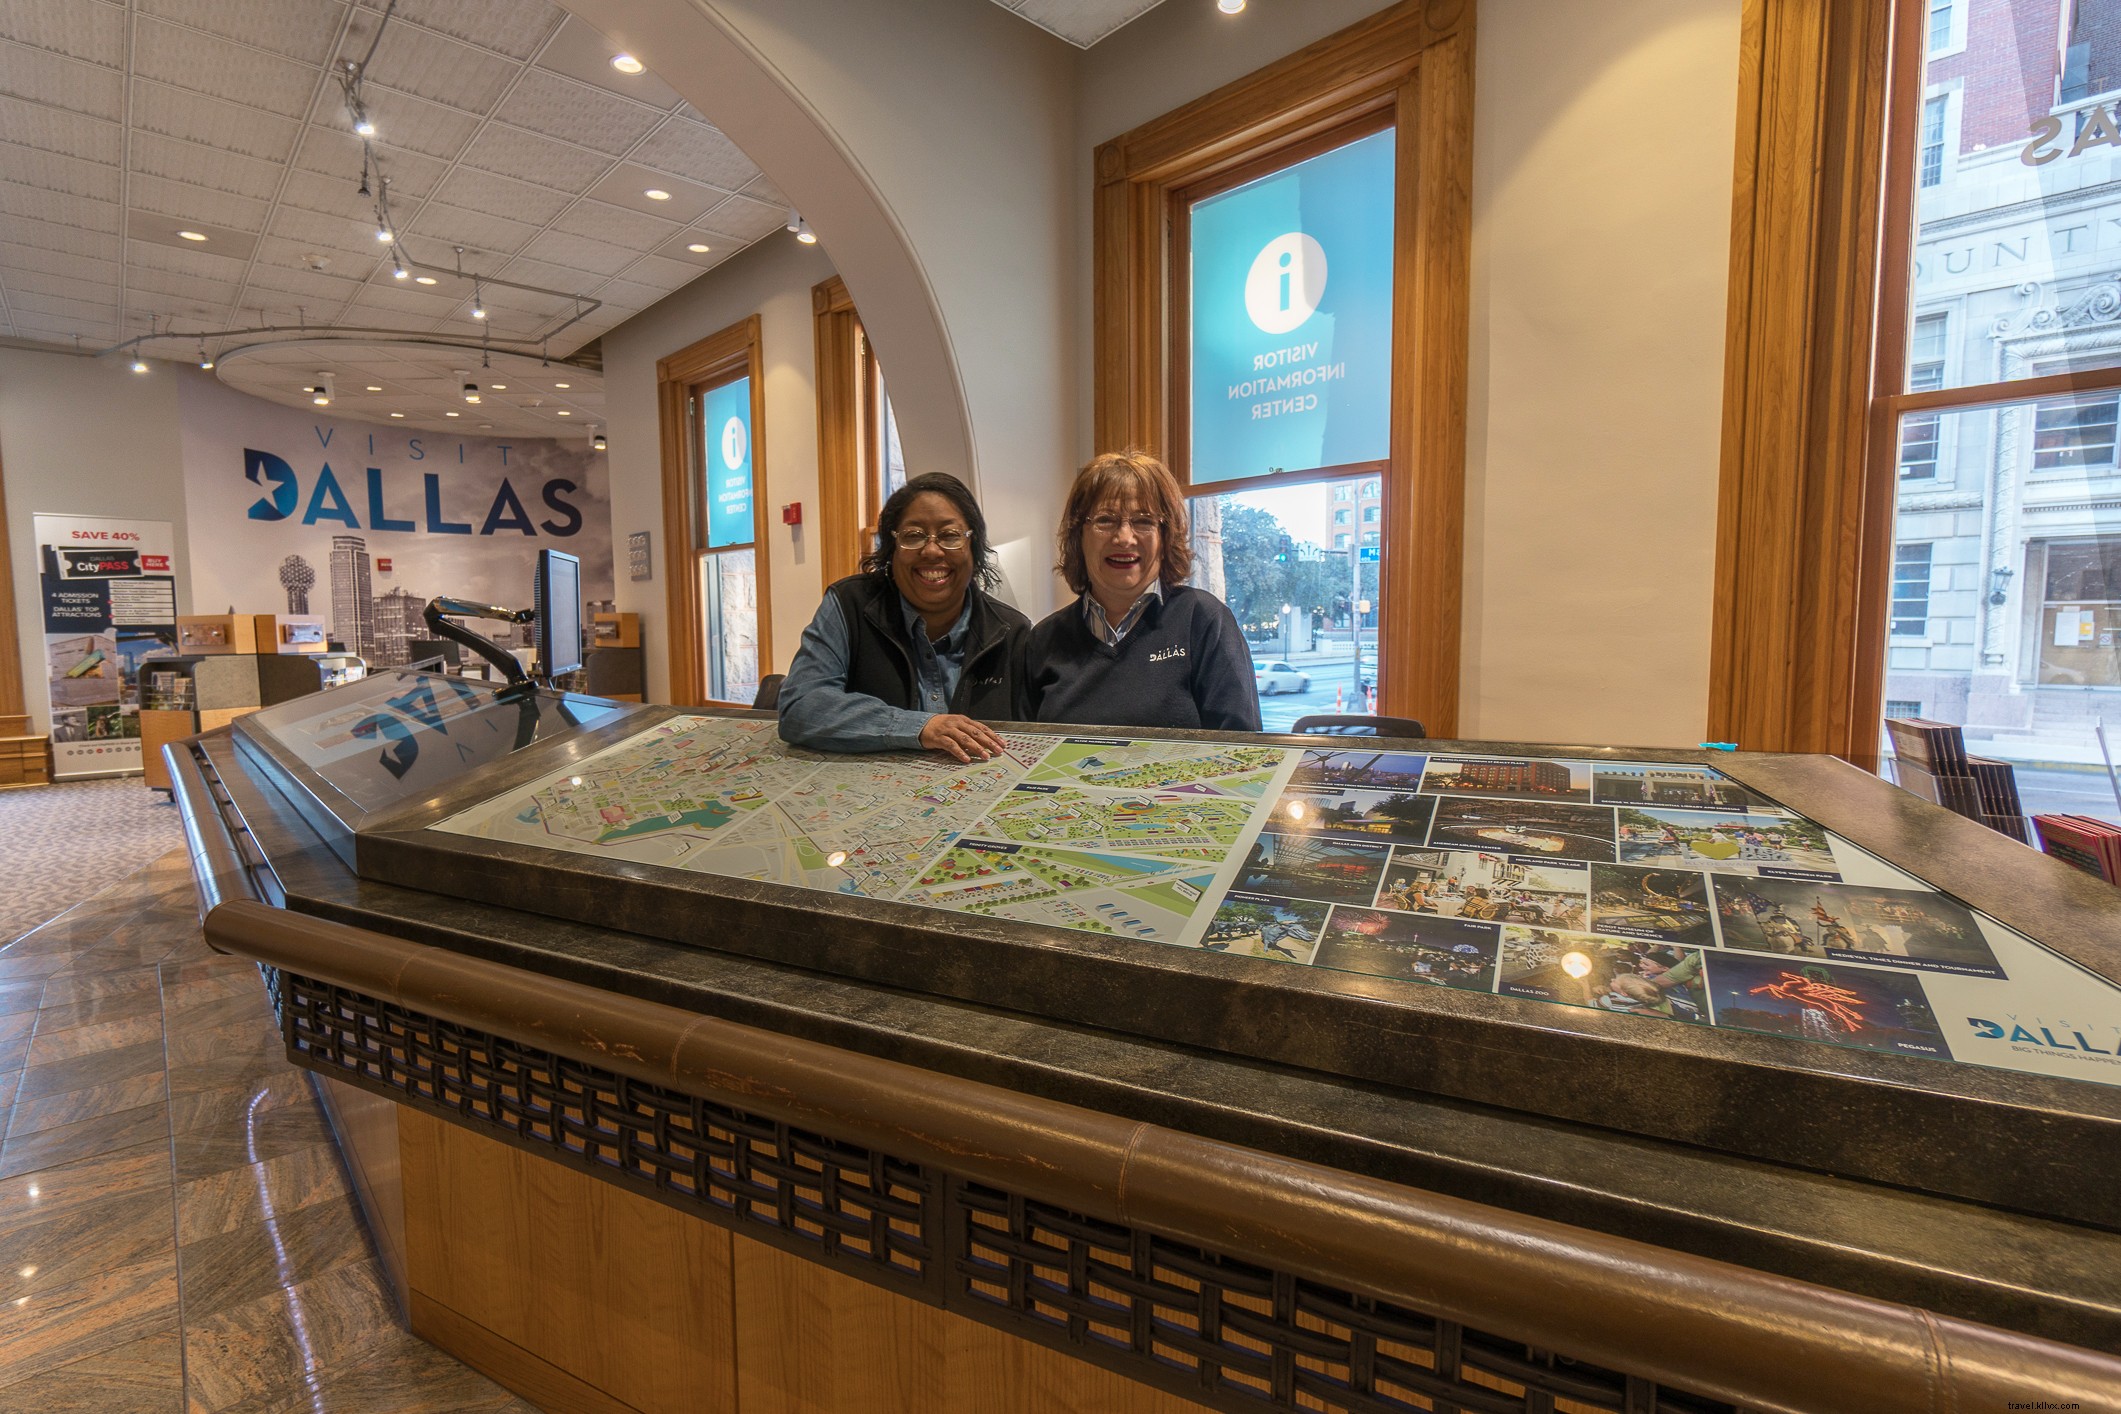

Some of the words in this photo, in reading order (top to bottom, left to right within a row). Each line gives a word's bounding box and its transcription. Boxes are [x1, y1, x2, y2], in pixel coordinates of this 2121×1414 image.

[315, 425, 513, 466] VISIT
[243, 447, 583, 537] DALLAS
[72, 530, 109, 540] SAVE
[112, 532, 141, 541] 40%
[77, 561, 129, 572] CityPASS
[1149, 645, 1186, 662] DALLAS
[1831, 952, 1868, 960] MEDIEVAL
[1892, 959, 1921, 967] DINNER
[1940, 964, 1996, 975] TOURNAMENT
[1967, 1017, 2121, 1057] DALL
[1897, 1042, 1937, 1052] PEGASUS
[2011, 1045, 2032, 1053] BIG
[2032, 1048, 2078, 1060] THINGS
